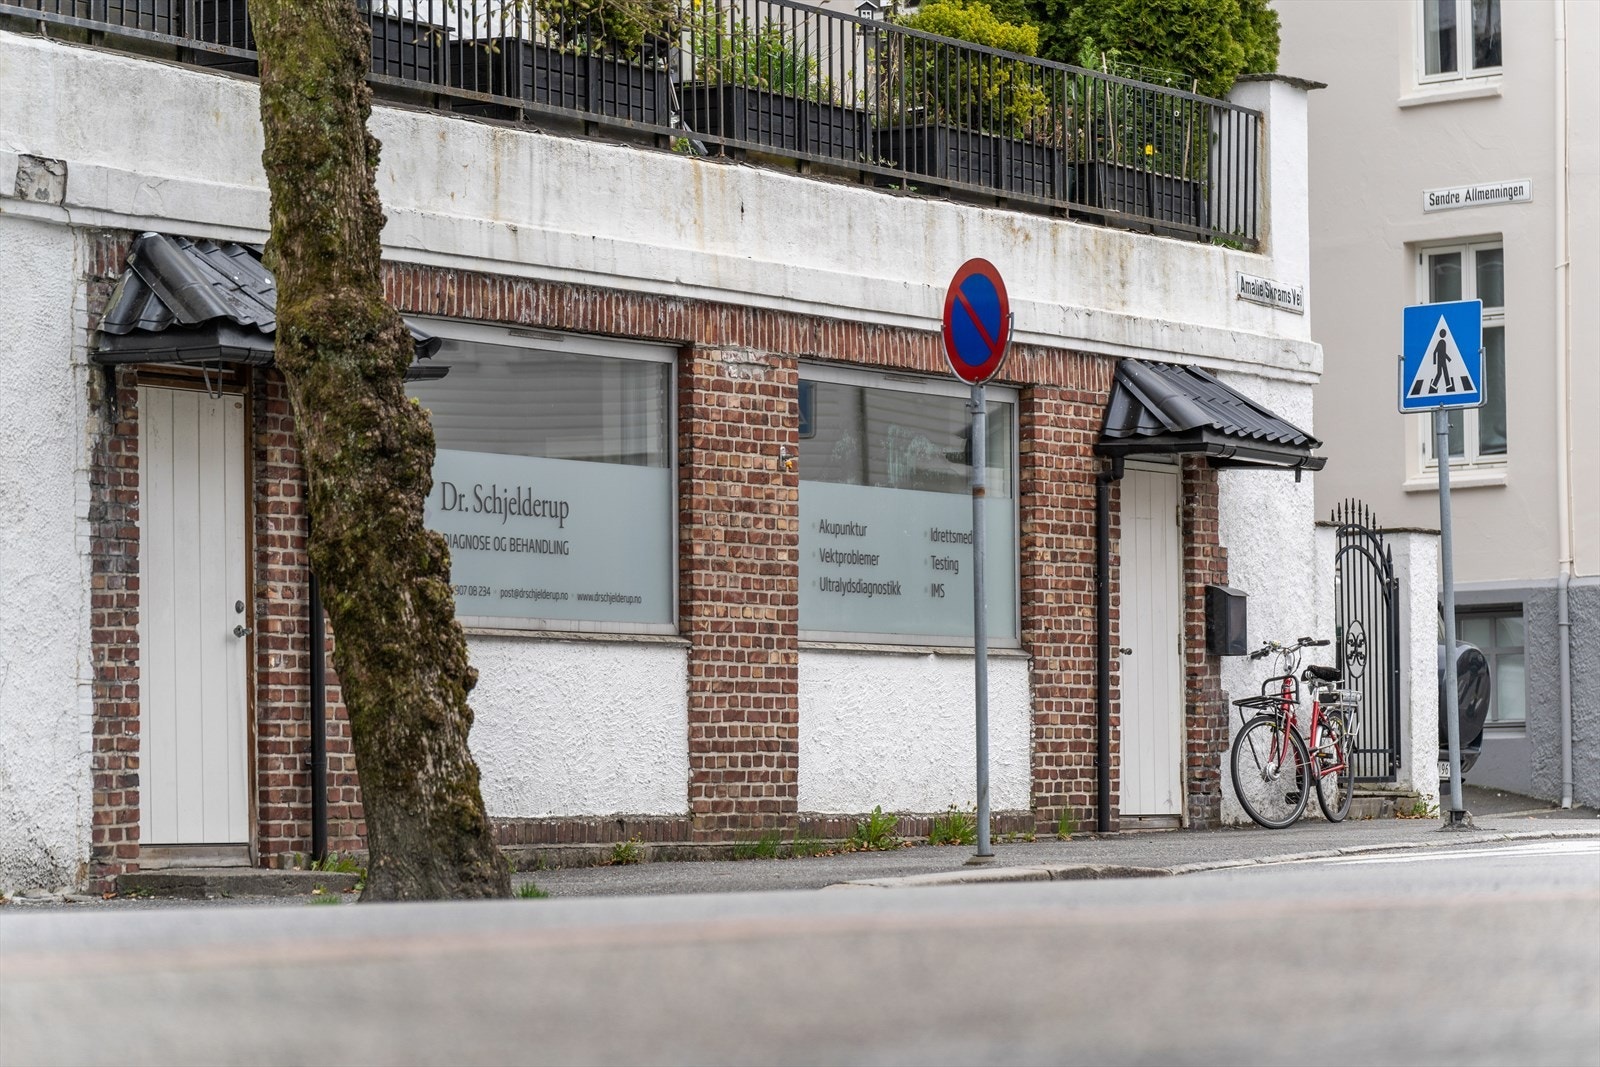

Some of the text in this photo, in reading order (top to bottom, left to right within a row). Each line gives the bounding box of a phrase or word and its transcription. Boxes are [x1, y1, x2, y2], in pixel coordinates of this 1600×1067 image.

[1429, 184, 1524, 206] Søndre Allmenningen
[1240, 275, 1303, 307] Amalie Skrams Vei
[441, 481, 570, 528] Dr. Schjelderup
[819, 518, 868, 538] Akupunktur
[493, 536, 507, 552] OG
[509, 537, 570, 556] BEHANDLING
[819, 547, 880, 567] Vektproblemer
[930, 555, 959, 574] Testing
[468, 585, 478, 597] 08
[478, 586, 491, 597] 234
[500, 588, 569, 602] post@drschjelderup.no
[577, 591, 642, 605] www.drschjelderup.no
[819, 576, 902, 598] Ultralydsdiagnostikk
[931, 583, 946, 598] IMS
